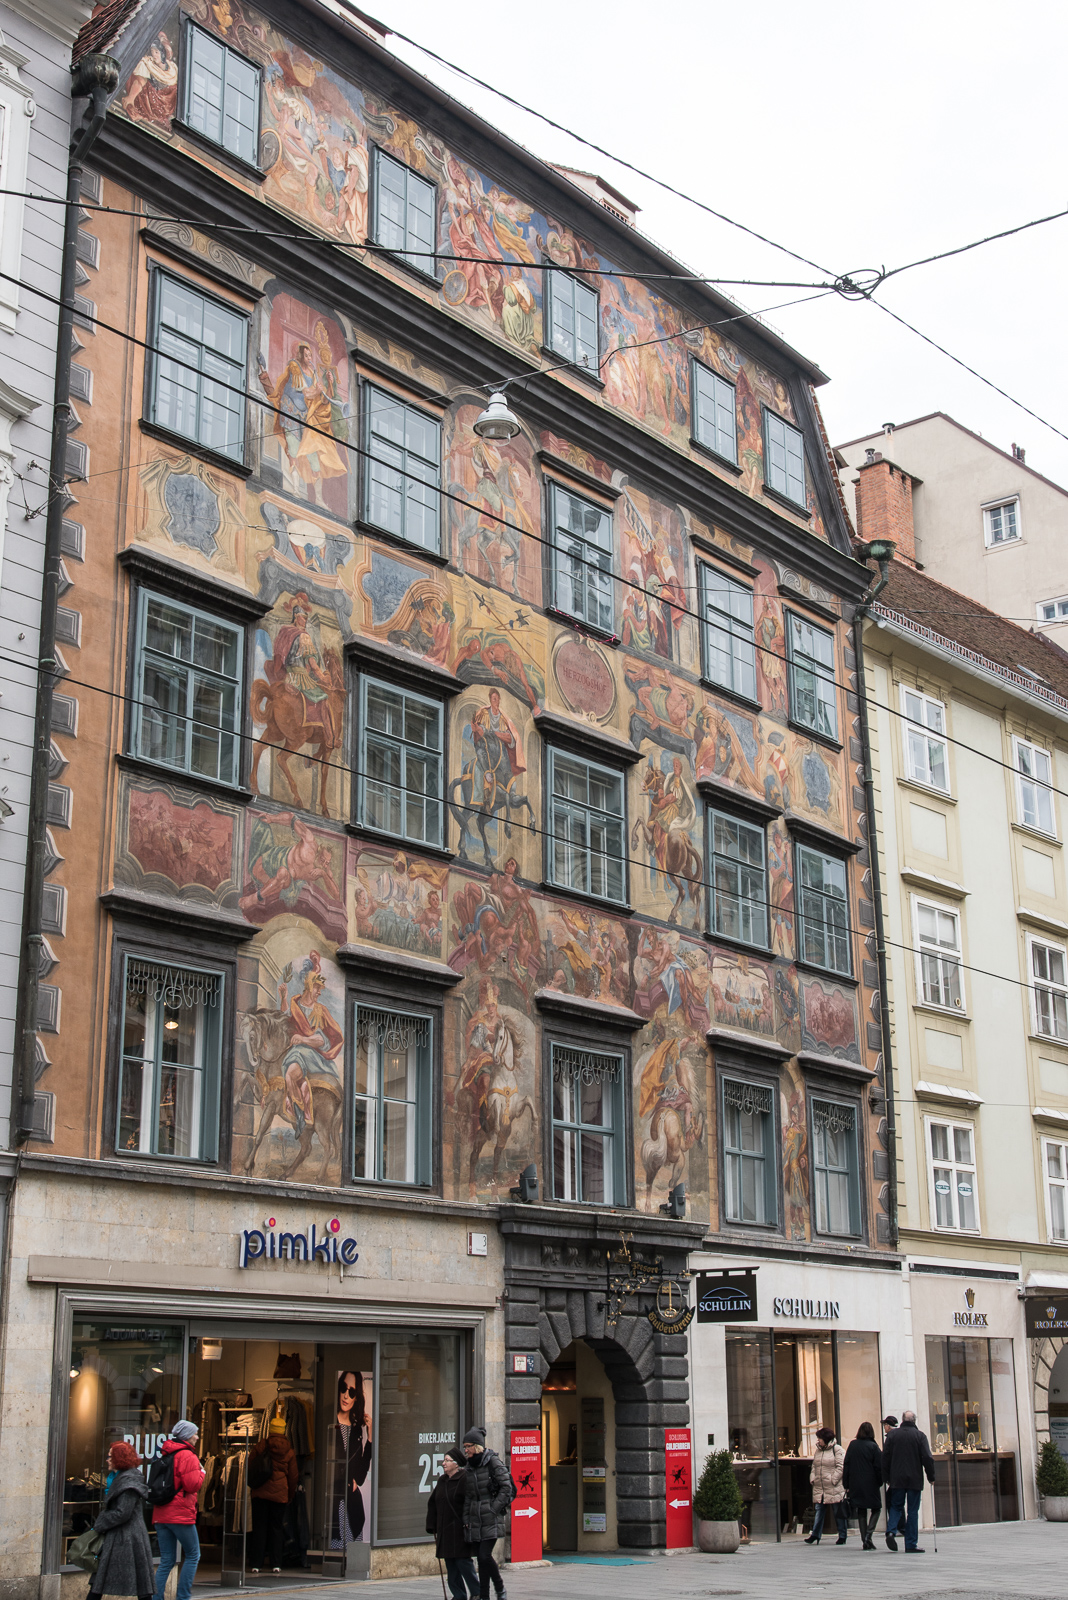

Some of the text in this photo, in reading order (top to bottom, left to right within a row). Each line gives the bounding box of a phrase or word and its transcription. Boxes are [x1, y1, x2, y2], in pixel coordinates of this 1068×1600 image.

[562, 666, 607, 694] HERZOGSHOF
[239, 1217, 359, 1268] pimkie
[482, 1235, 487, 1247] 3
[699, 1299, 752, 1312] SCHULLIN
[774, 1297, 841, 1319] SCHULLIN
[953, 1311, 989, 1327] ROLEX
[1034, 1320, 1068, 1329] ROLEX
[418, 1432, 456, 1444] BIKERJACKE
